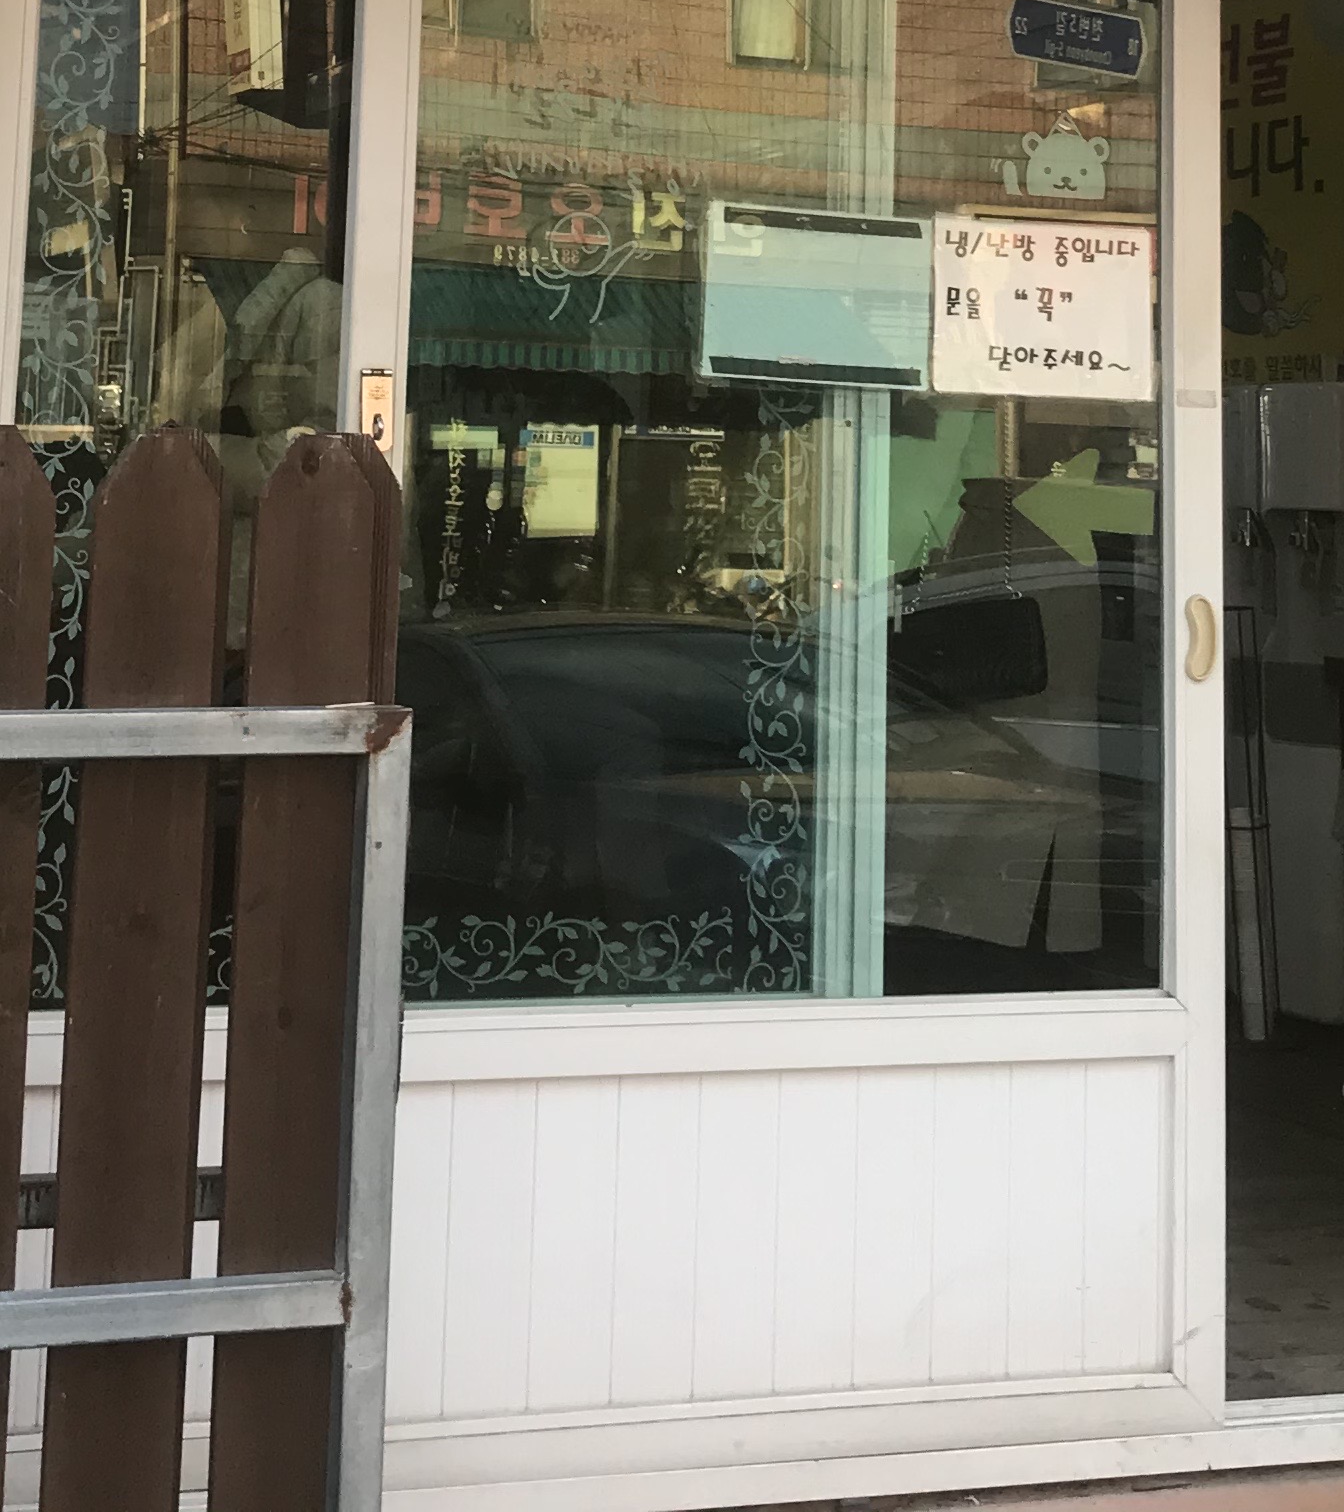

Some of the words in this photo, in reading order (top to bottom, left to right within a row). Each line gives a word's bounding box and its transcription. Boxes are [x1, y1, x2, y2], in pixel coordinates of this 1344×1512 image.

[945, 230, 1036, 262] 냉/난방
[1054, 235, 1140, 268] 중입니다
[946, 286, 981, 320] 문을
